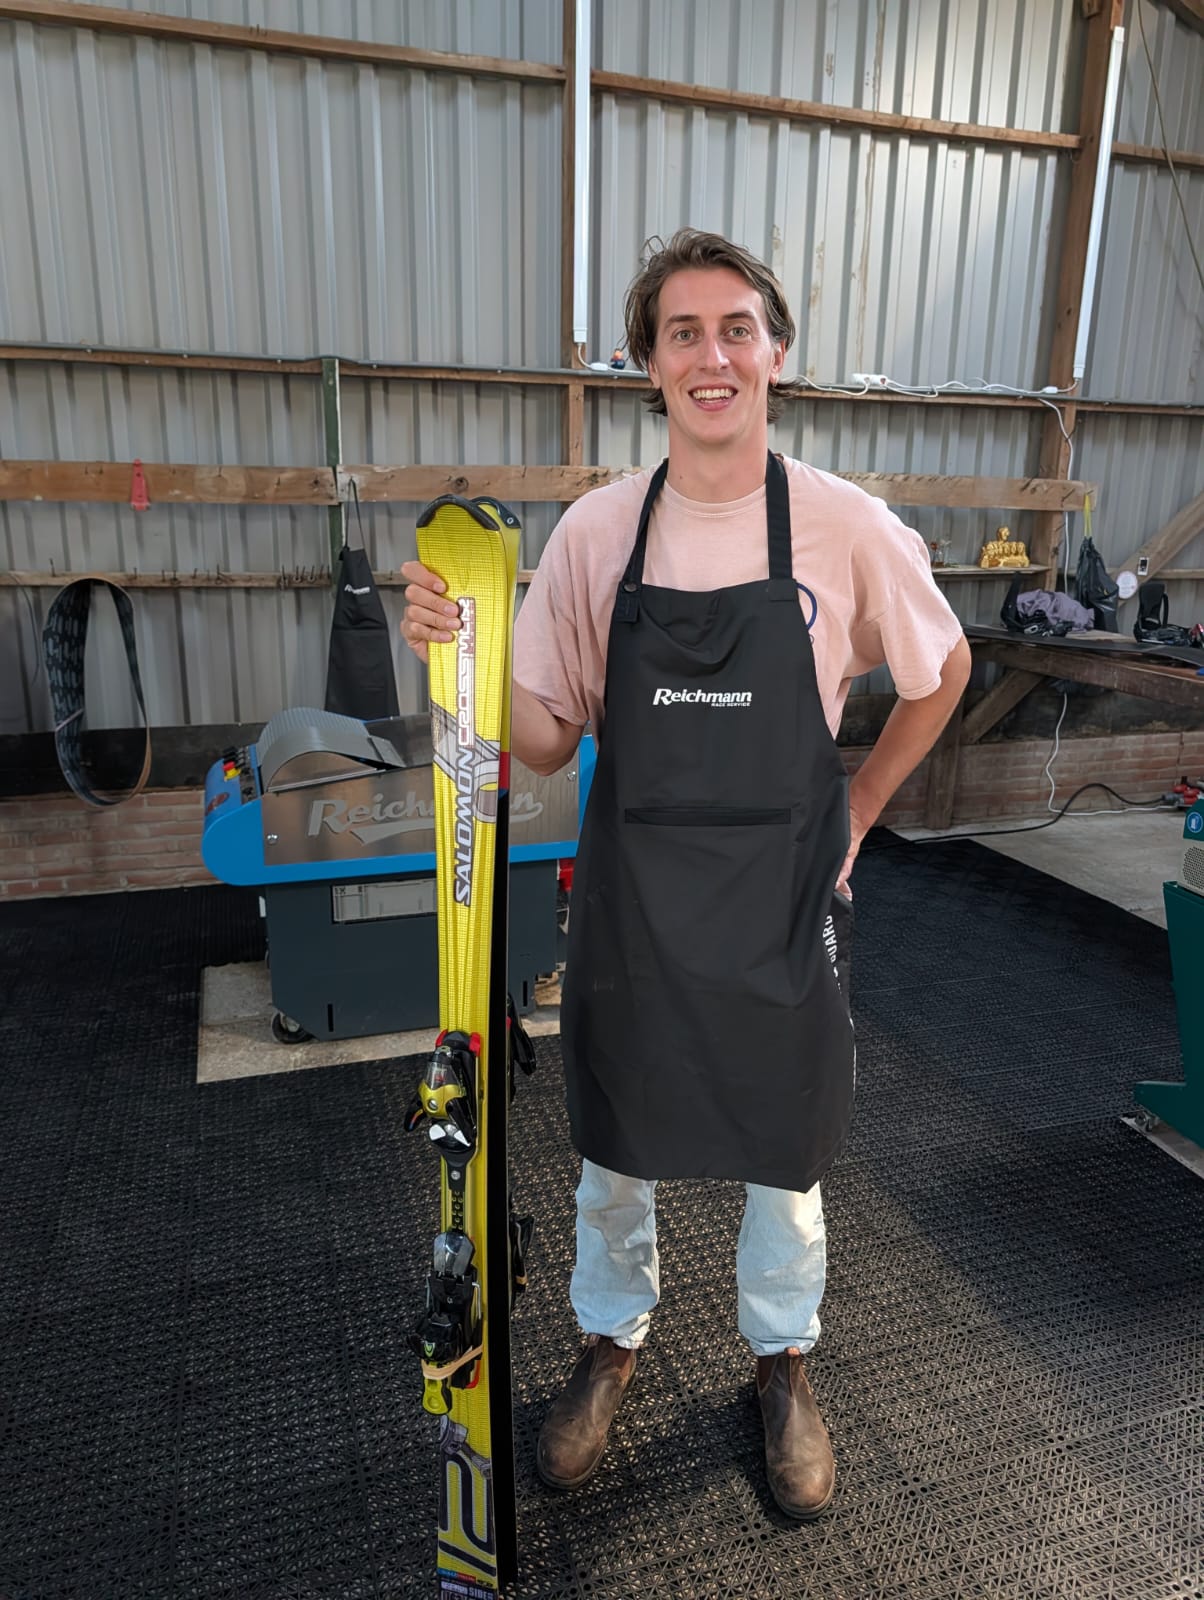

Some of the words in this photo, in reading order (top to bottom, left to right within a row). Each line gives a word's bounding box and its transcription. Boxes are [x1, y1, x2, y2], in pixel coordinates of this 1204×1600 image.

[652, 688, 752, 705] Reichmann
[307, 790, 543, 842] Reichn
[455, 747, 474, 906] SALOMON
